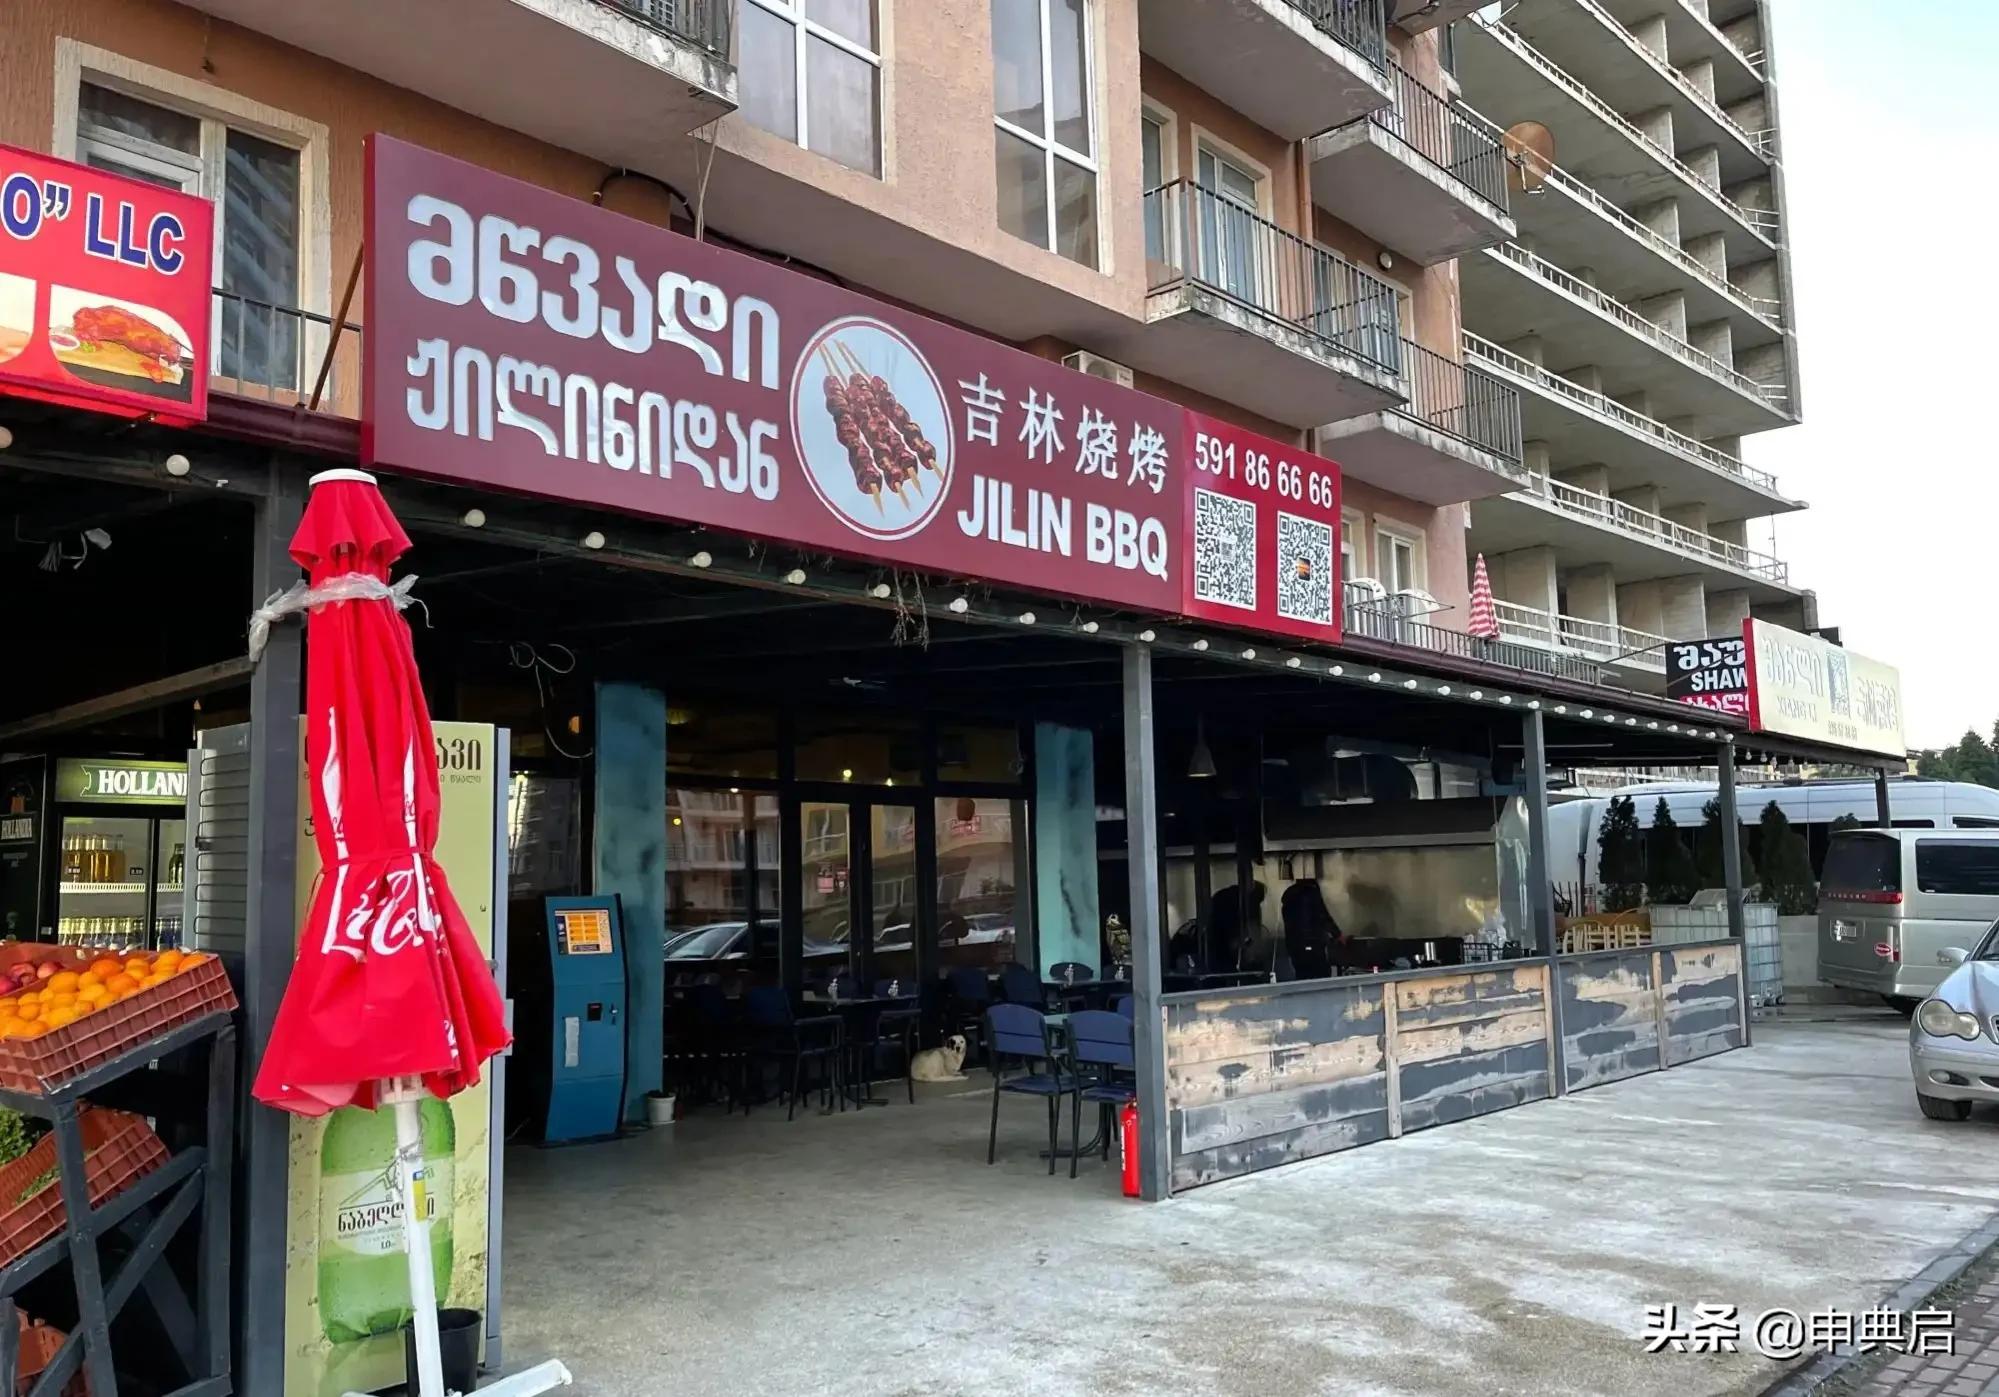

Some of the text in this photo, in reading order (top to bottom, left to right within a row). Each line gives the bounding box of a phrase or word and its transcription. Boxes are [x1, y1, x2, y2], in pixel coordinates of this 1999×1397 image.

[85, 191, 186, 274] LLC
[407, 193, 780, 390] მწვადი
[407, 338, 780, 501] ჟილინიდან
[957, 371, 1169, 494] 吉林烧烤
[1195, 432, 1333, 510] 591 86 66 66
[957, 474, 1169, 582] JILIN BBQ
[97, 769, 188, 797] HOLLAN
